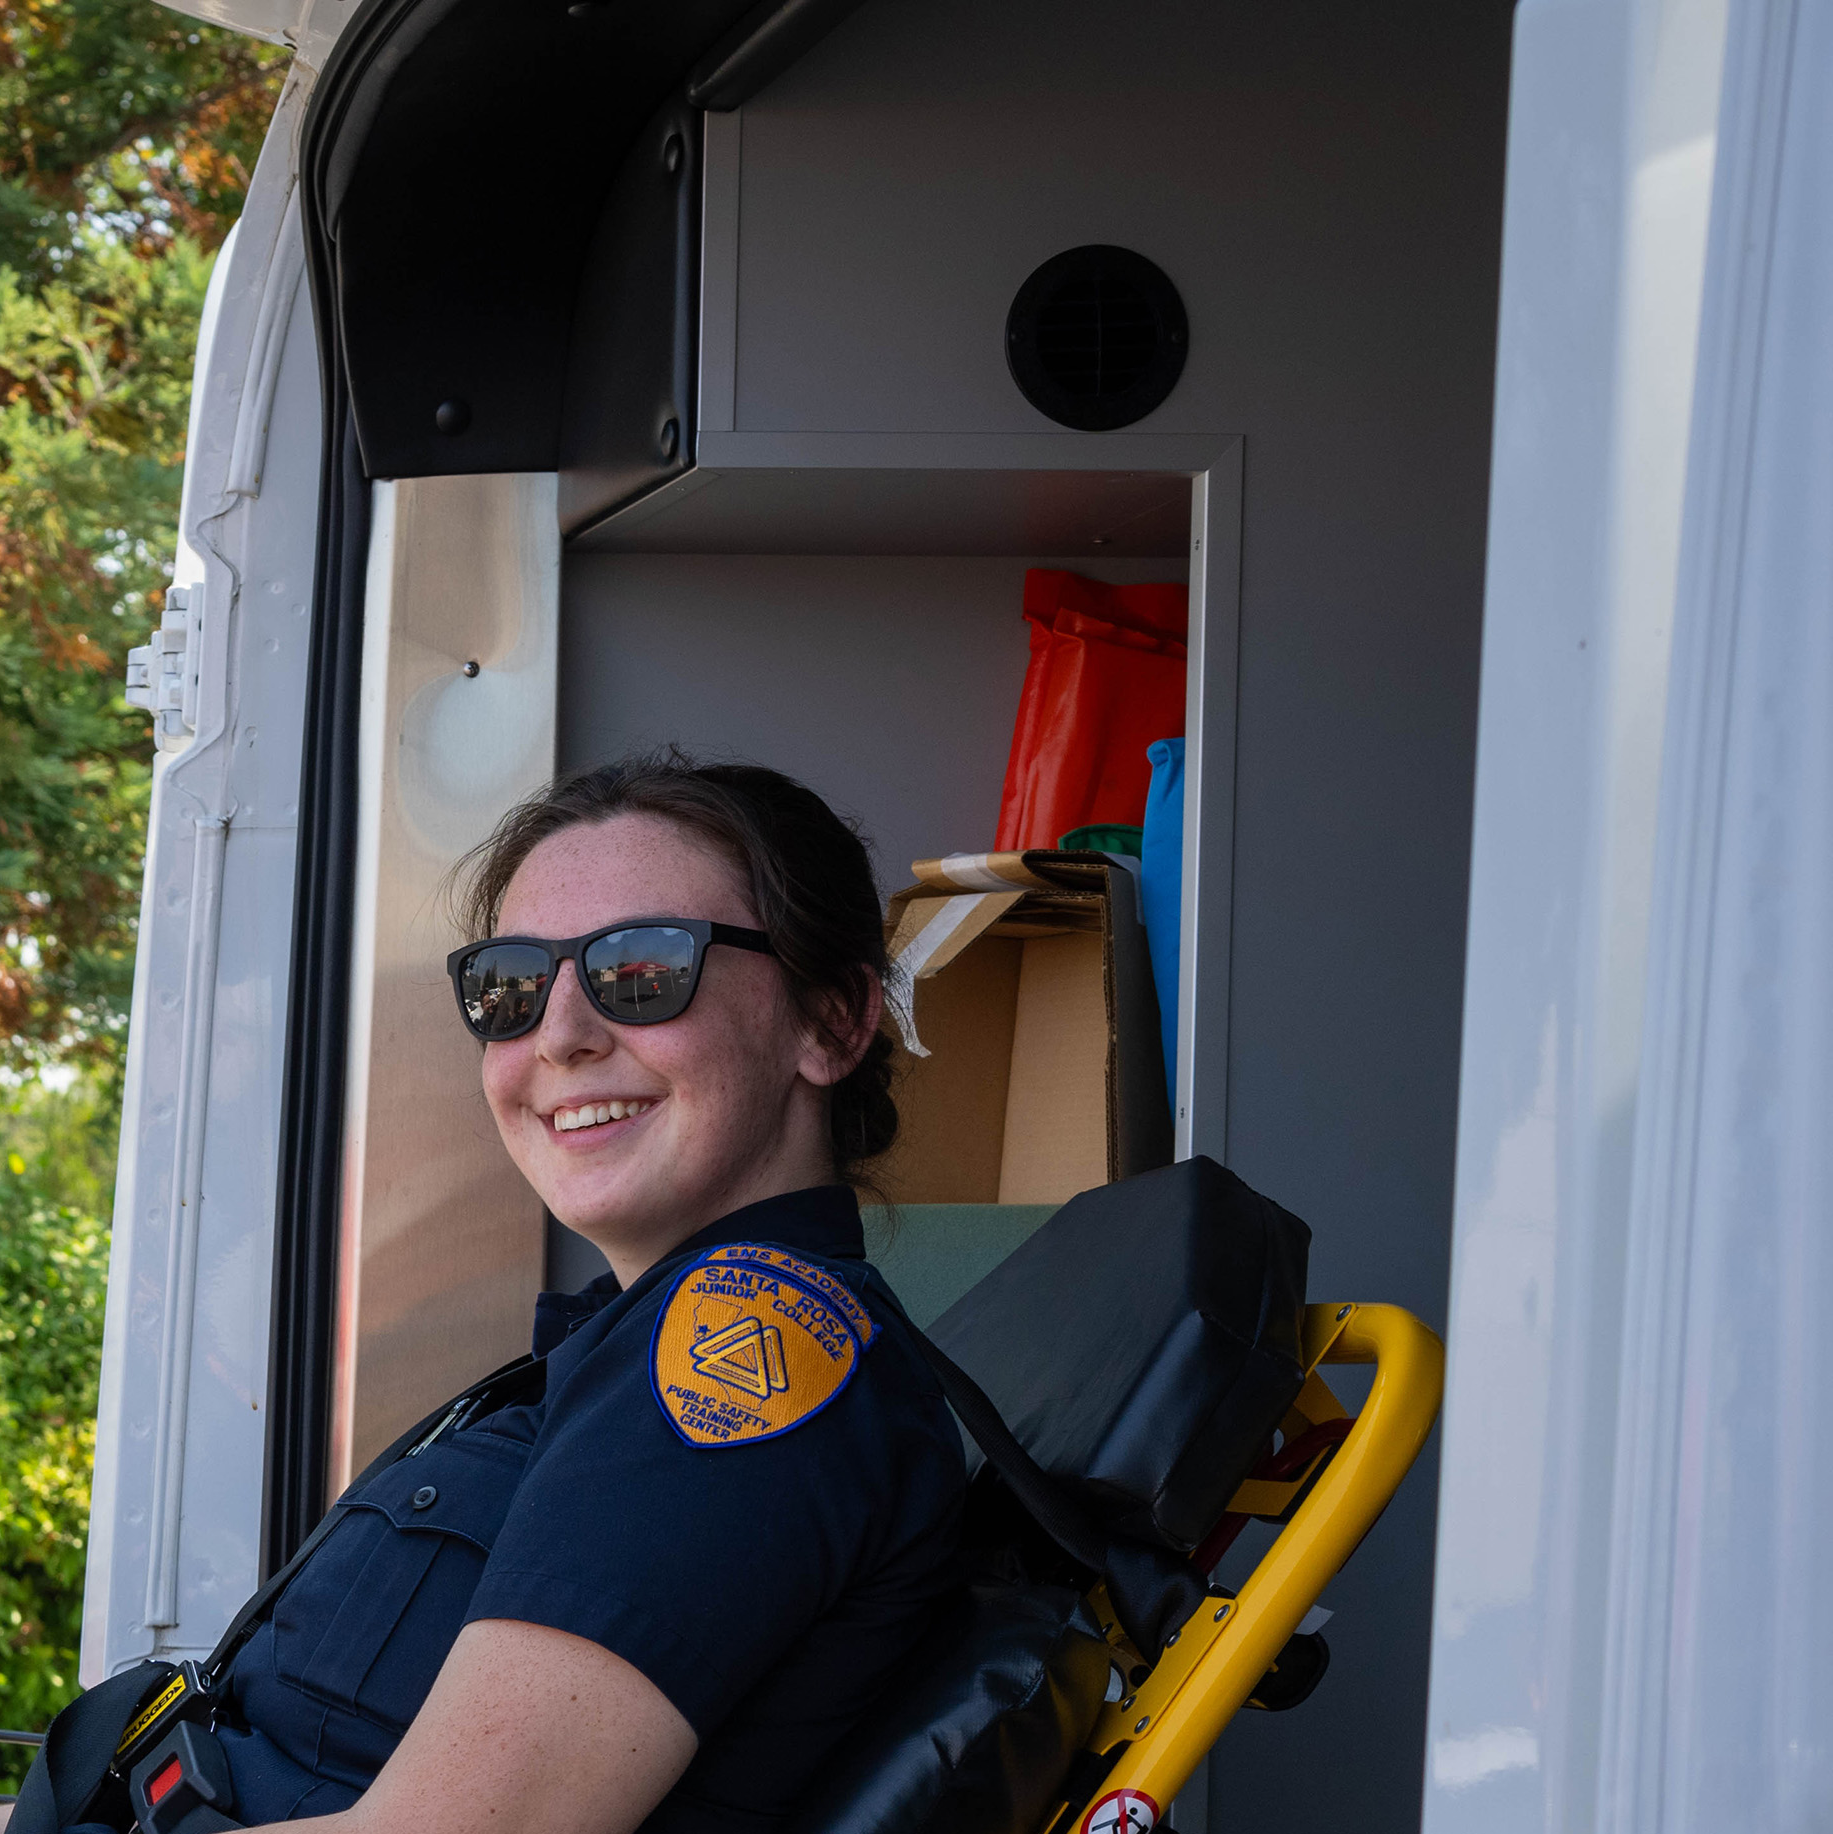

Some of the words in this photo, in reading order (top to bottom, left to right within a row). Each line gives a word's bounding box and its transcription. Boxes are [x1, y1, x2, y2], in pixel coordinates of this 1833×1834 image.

[705, 1268, 780, 1296] SANTA
[795, 1297, 848, 1348] ROSA
[726, 1248, 771, 1260] EMS
[780, 1258, 864, 1322] ACADEMY
[690, 1282, 758, 1301] JUNIOR
[772, 1299, 845, 1362] COLLEGE
[667, 1384, 717, 1409] PUBLIC
[718, 1402, 771, 1431] SAFETY
[680, 1414, 731, 1440] CENTER
[682, 1401, 742, 1432] TRAINING
[126, 1689, 175, 1740] RUGGED
